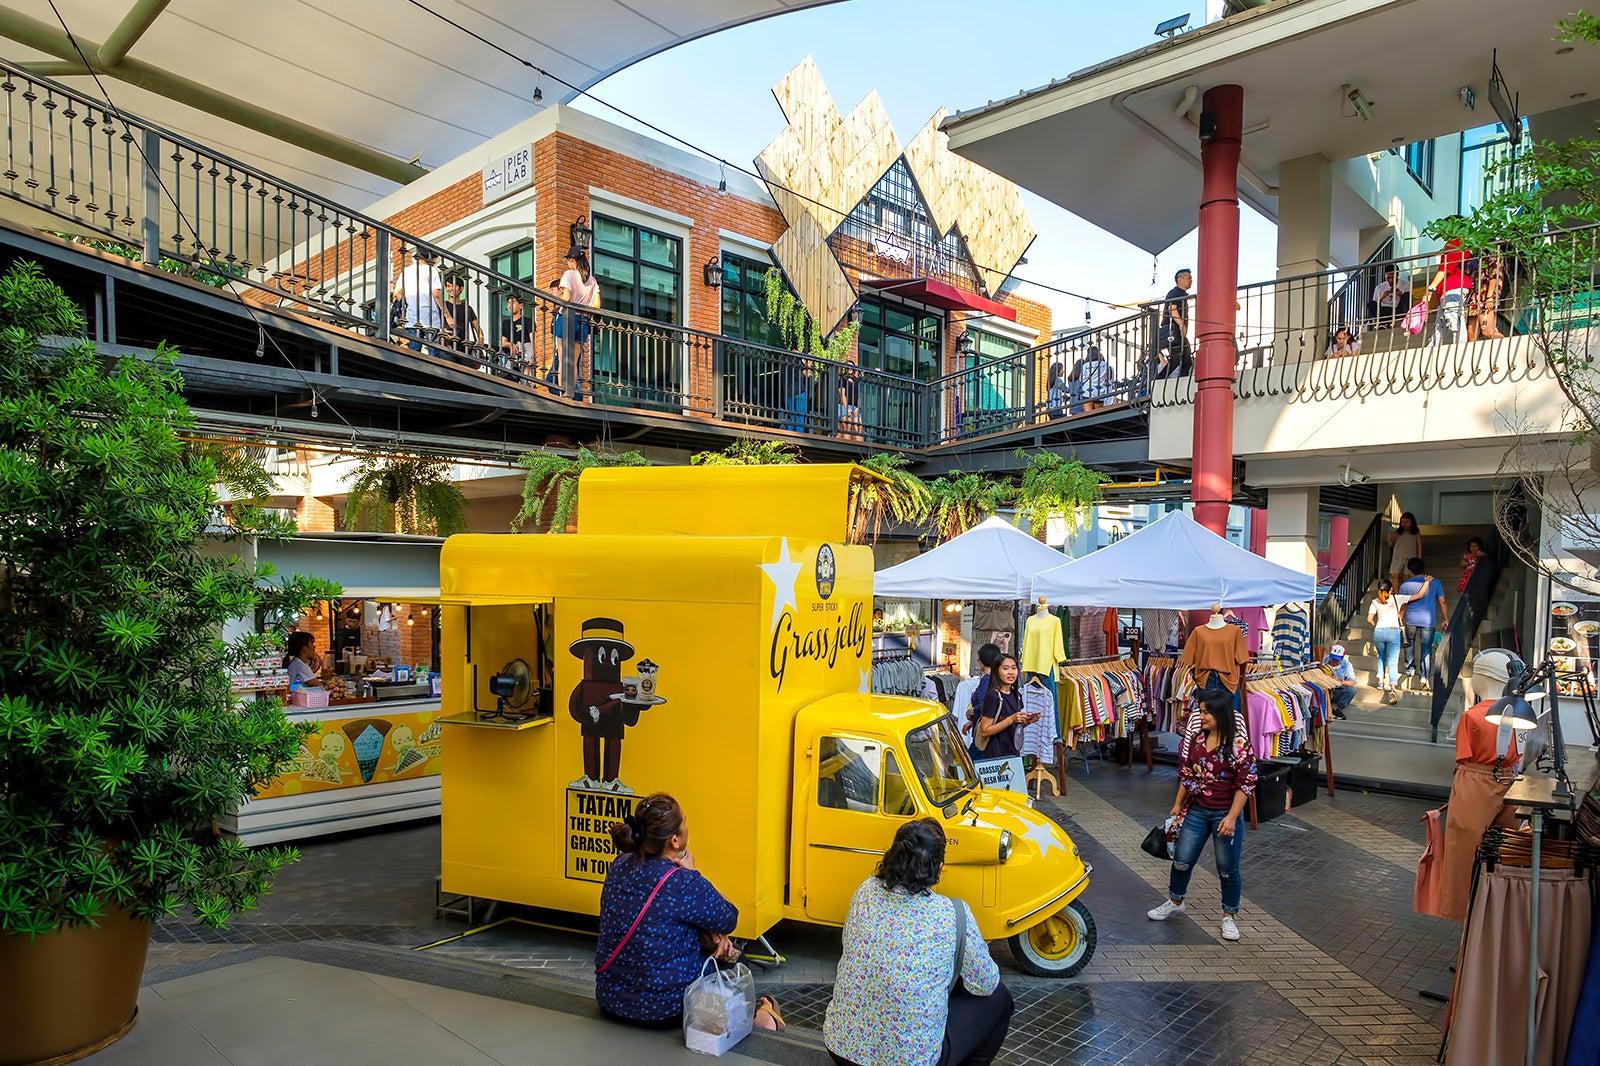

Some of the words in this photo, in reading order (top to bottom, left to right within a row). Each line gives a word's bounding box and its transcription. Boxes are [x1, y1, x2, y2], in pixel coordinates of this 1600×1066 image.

[507, 149, 529, 170] PIER
[507, 165, 527, 184] LAB
[770, 612, 829, 695] Grass
[828, 602, 867, 669] jelly
[570, 816, 591, 832] THE
[593, 819, 620, 835] BES
[945, 838, 960, 846] PEN
[576, 857, 588, 872] IN
